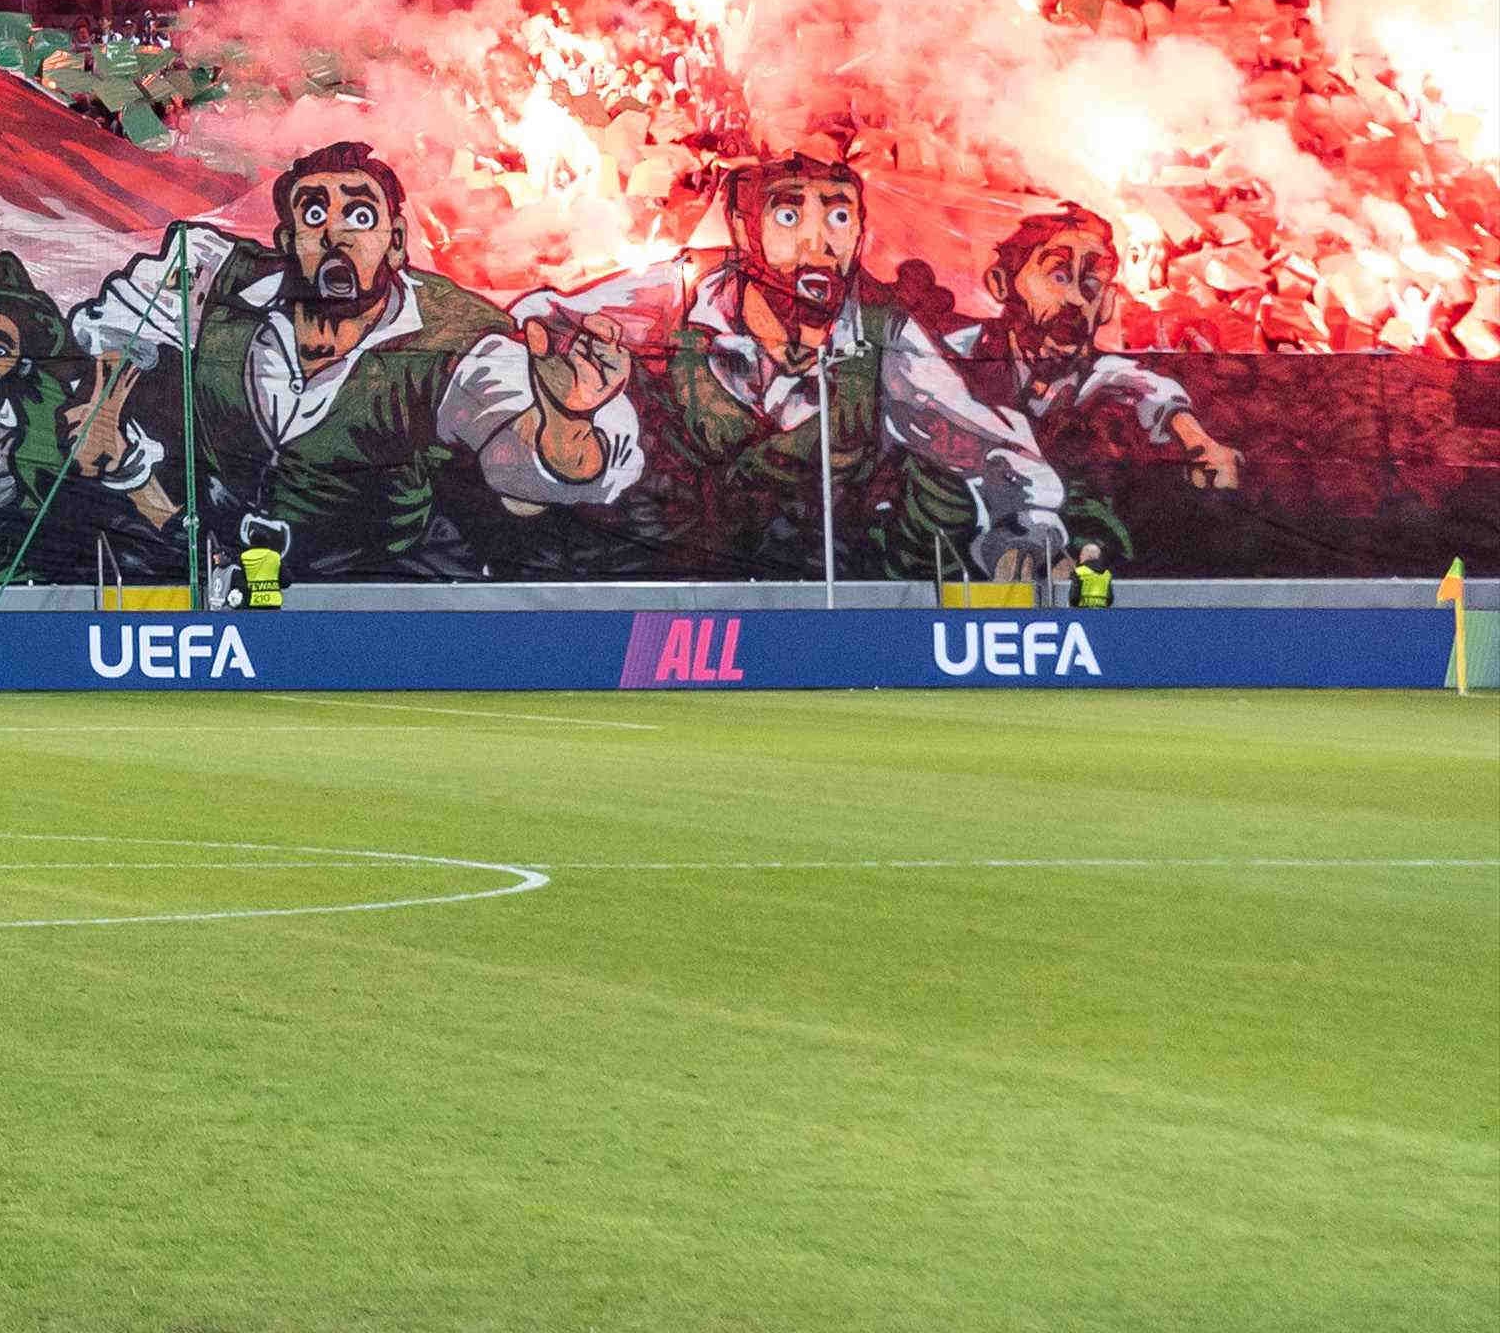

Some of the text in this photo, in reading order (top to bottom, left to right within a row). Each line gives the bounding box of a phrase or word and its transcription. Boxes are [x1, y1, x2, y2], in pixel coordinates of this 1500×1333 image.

[88, 624, 256, 678] UEFA
[655, 619, 744, 681] ALL
[932, 621, 1101, 676] UEFA
